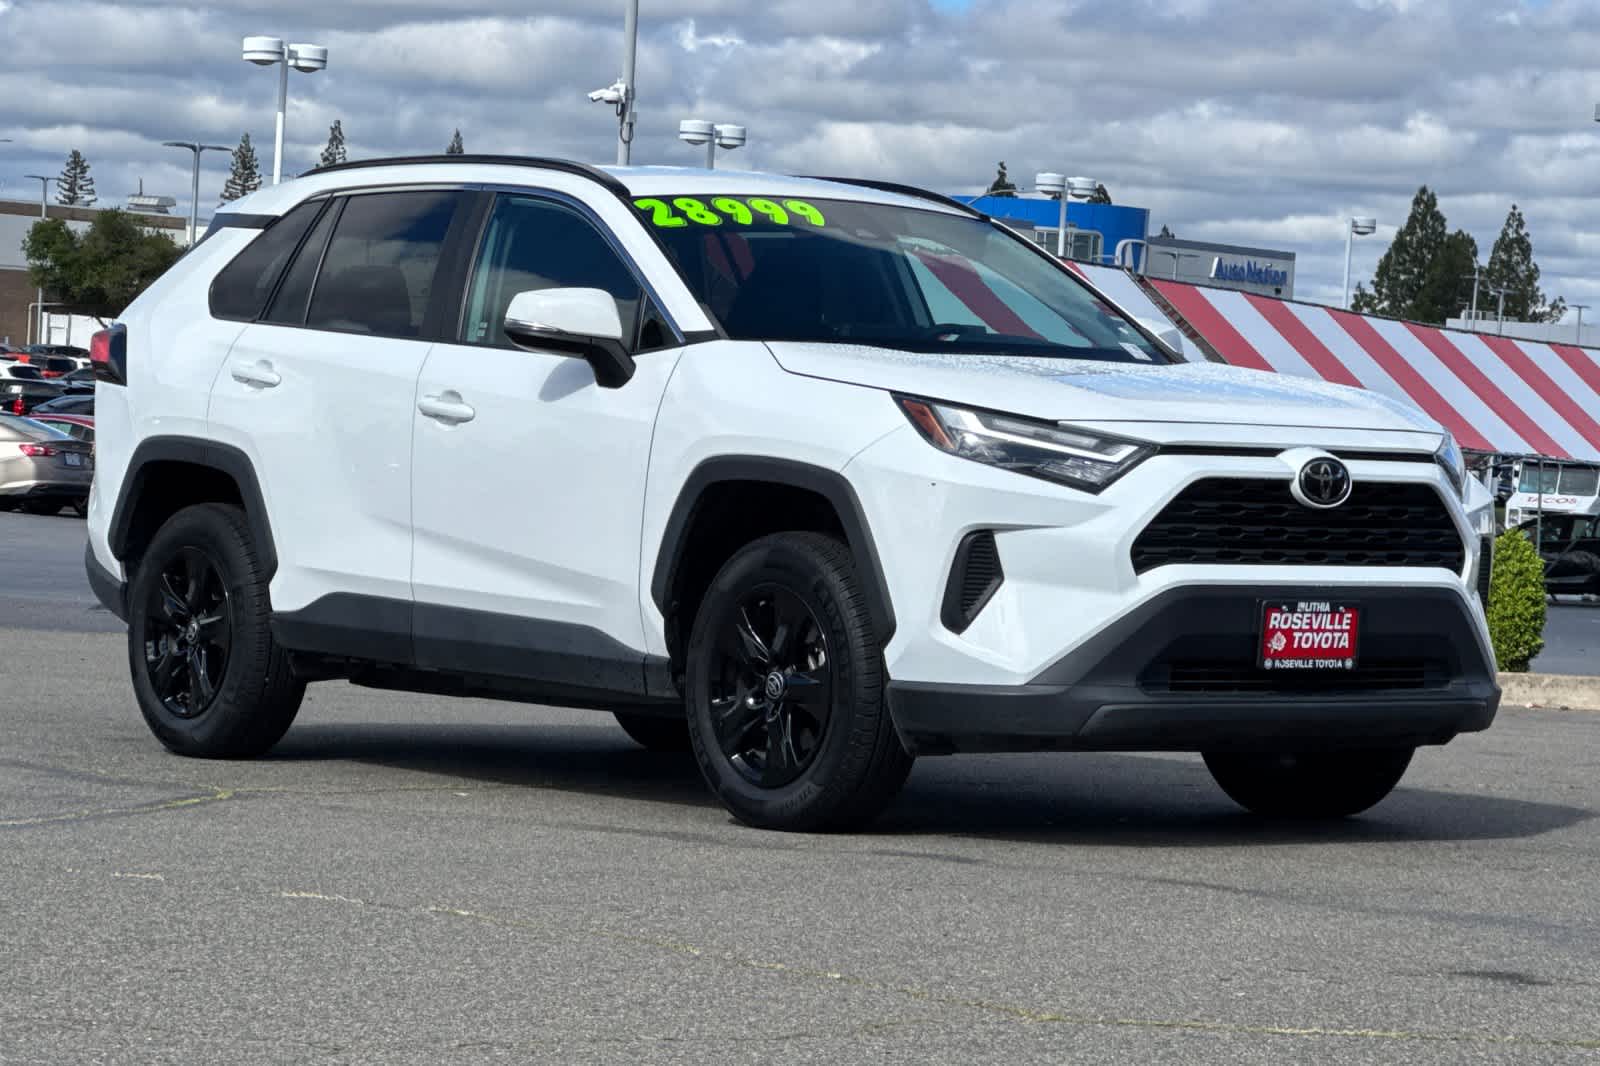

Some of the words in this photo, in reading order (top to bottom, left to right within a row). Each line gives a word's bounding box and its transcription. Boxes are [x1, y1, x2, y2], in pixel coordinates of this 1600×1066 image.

[633, 197, 825, 228] 28999
[1304, 602, 1330, 612] LITHIA
[1269, 612, 1352, 630] ROSEVILLE
[1293, 632, 1349, 649] TOYOTA
[1274, 659, 1313, 669] ROSEVILLE
[1315, 659, 1343, 669] TOYOTA
